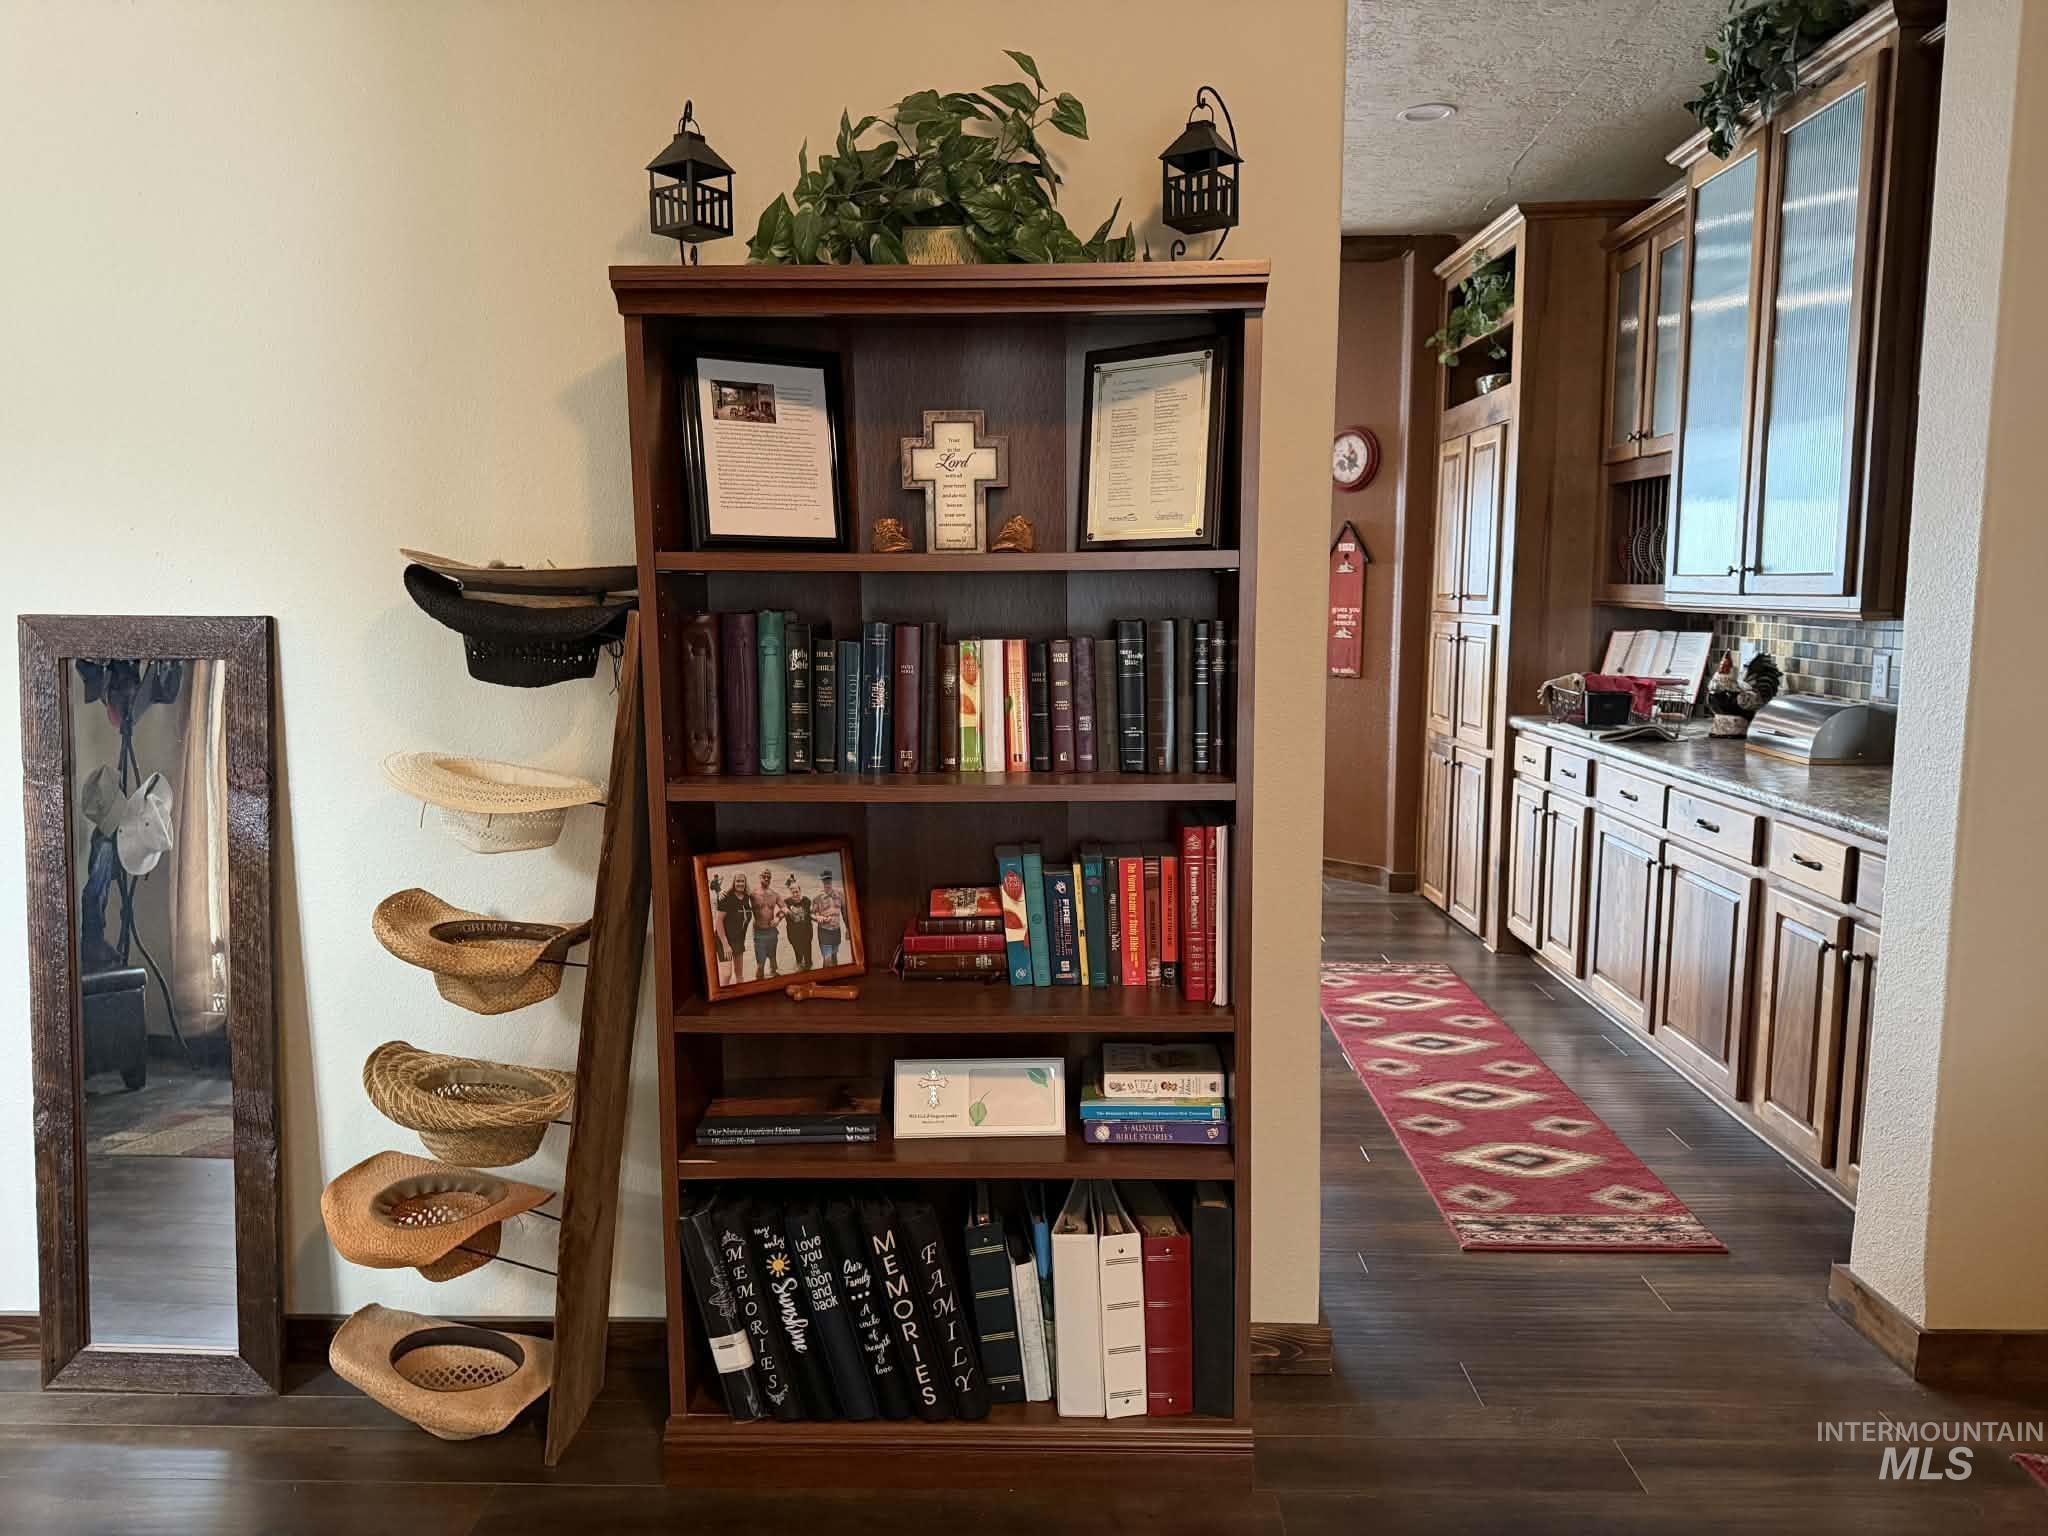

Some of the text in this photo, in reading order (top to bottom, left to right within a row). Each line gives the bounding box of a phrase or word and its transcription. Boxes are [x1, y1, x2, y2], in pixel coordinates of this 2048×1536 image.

[935, 451, 977, 472] Lord
[789, 649, 808, 660] Holy
[790, 660, 809, 671] Bible
[463, 922, 508, 933] GRIMM
[707, 1128, 722, 1136] Our
[754, 1225, 770, 1239] my
[795, 1235, 821, 1253] love
[800, 1249, 823, 1268] you
[843, 1259, 863, 1274] Our
[812, 1284, 833, 1300] and
[725, 1245, 778, 1389] MEMORIES
[771, 1277, 809, 1353] Sunshine
[873, 1230, 937, 1406] MEMORIES
[921, 1241, 974, 1393] FAMILY
